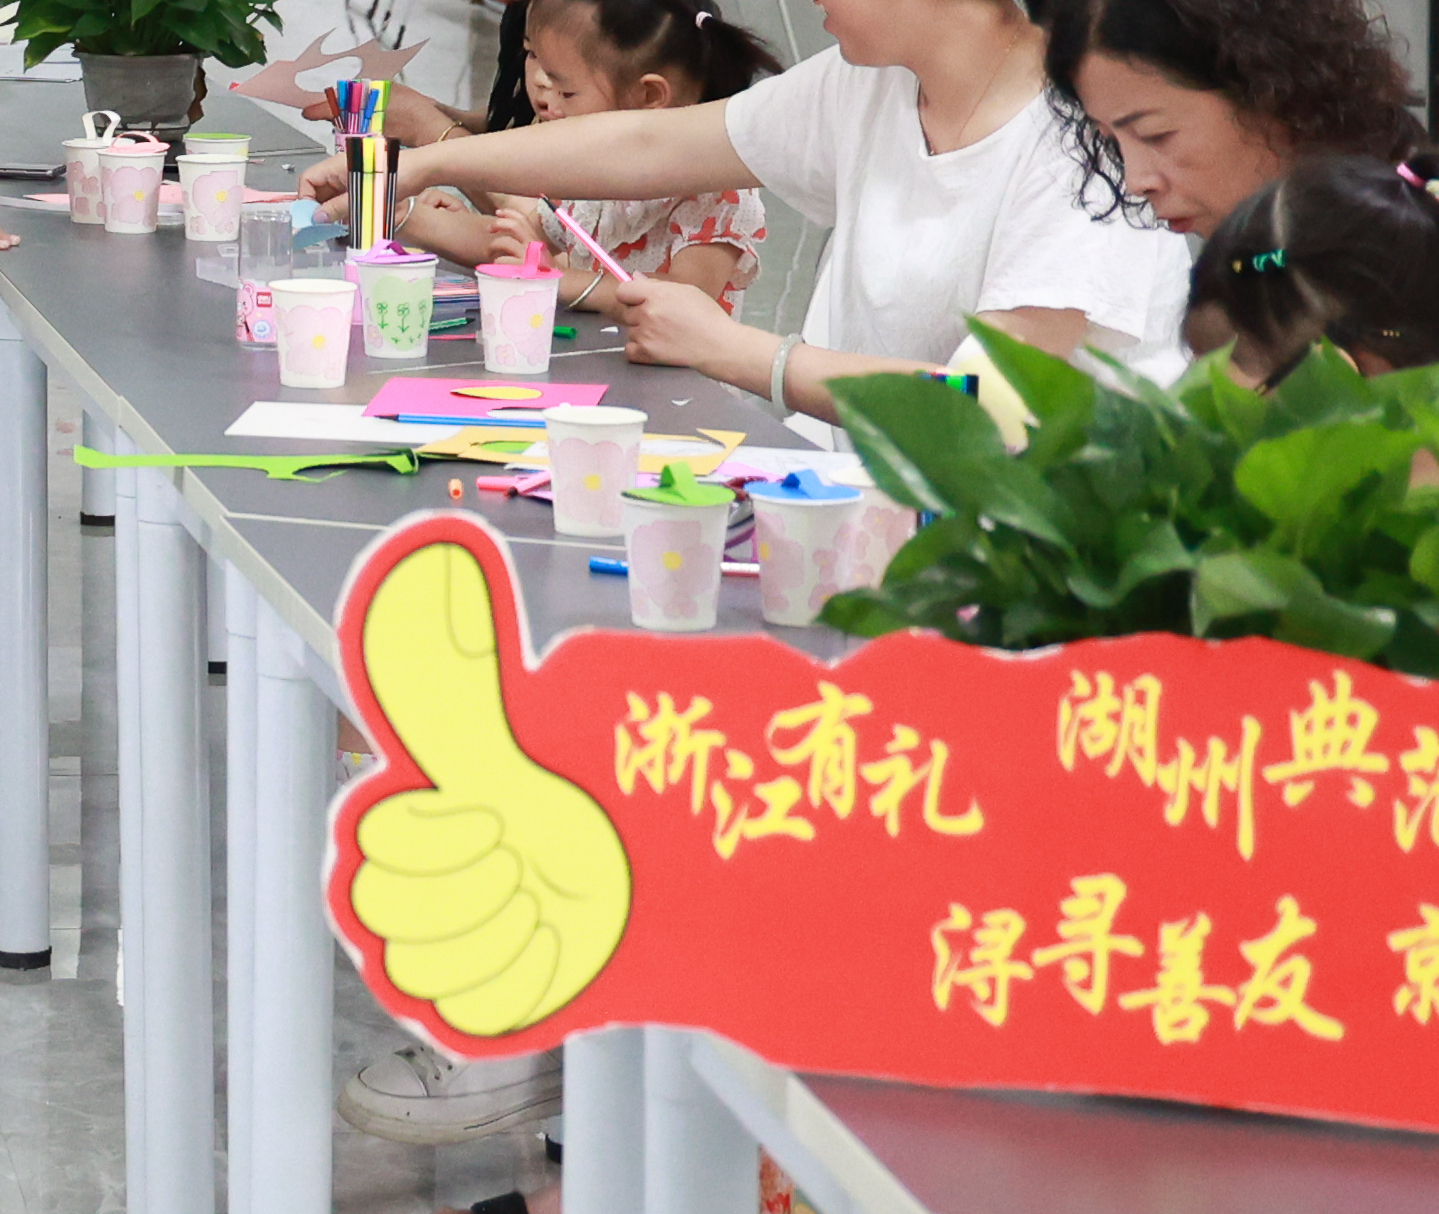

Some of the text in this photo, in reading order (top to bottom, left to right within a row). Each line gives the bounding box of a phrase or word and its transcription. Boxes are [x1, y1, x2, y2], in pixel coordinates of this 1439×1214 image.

[616, 683, 982, 857] 浙江有礼
[932, 874, 1343, 1043] 浔寻善友
